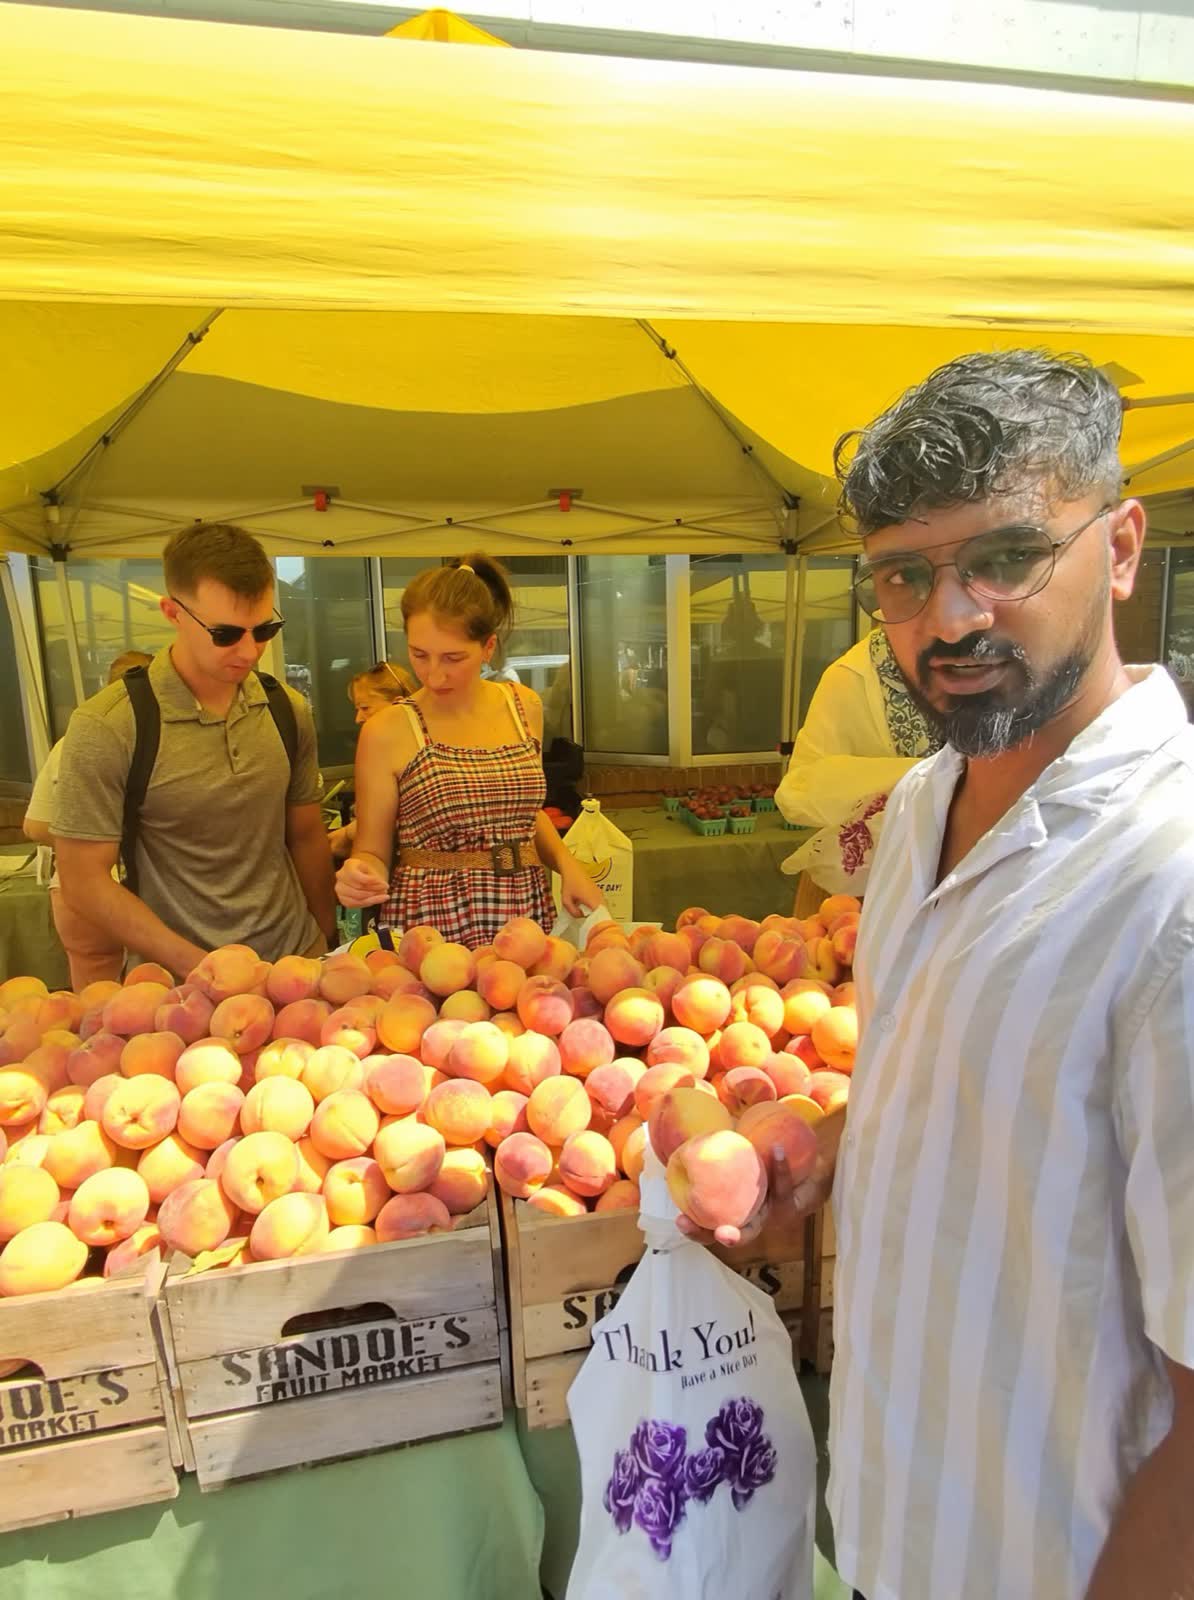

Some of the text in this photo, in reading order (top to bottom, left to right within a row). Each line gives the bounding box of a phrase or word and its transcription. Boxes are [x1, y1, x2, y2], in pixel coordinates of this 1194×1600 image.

[221, 1315, 471, 1387] SANDOE'S
[599, 1308, 756, 1373] Thank You!
[0, 1368, 129, 1421] OE'S
[255, 1353, 444, 1403] FRUIT MARKET
[681, 1352, 758, 1390] Have a Nice Day
[0, 1409, 99, 1445] ARKET
